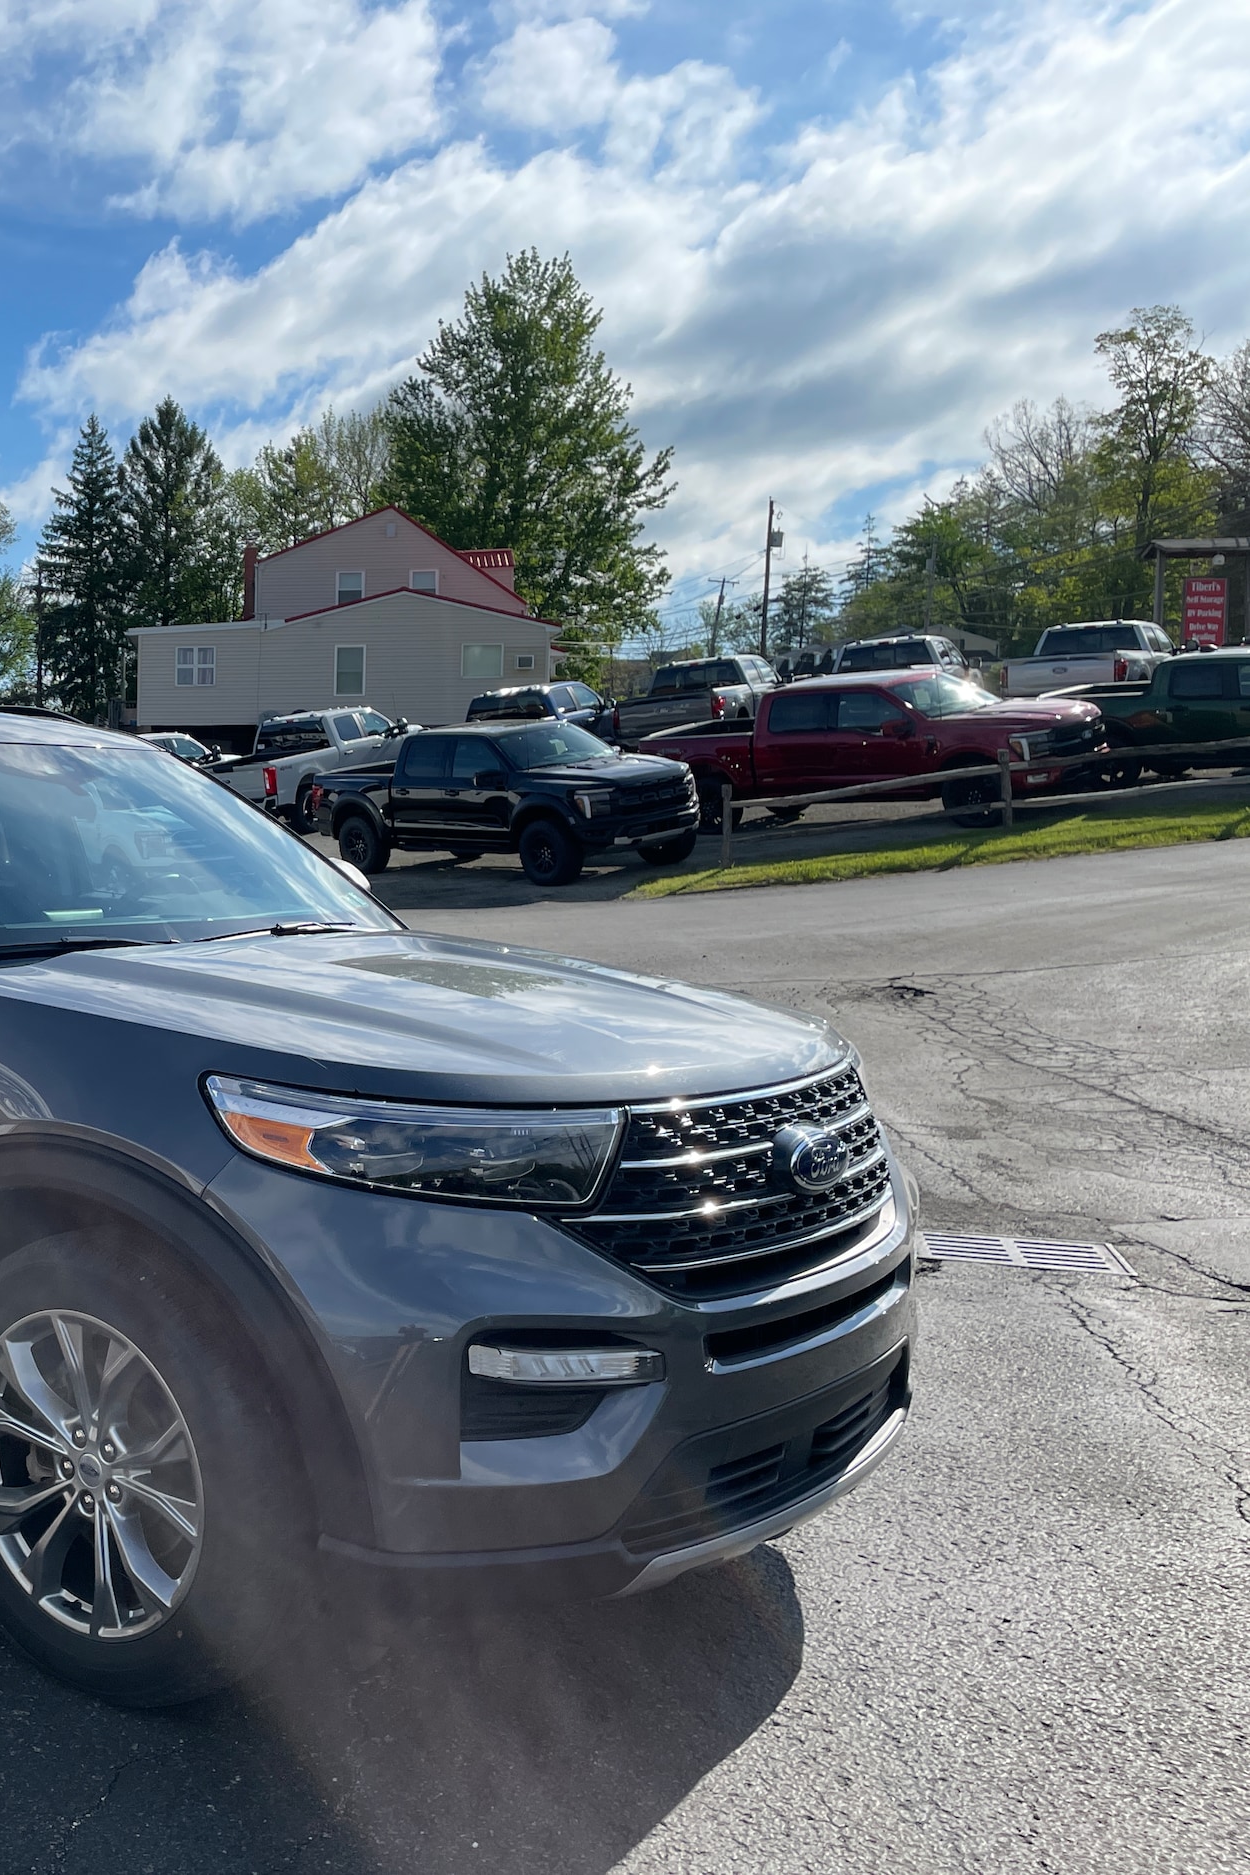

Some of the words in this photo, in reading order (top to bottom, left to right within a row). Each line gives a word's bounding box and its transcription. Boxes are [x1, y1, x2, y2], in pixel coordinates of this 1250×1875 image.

[1186, 595, 1199, 604] Self
[1200, 595, 1225, 605] Storage
[1187, 609, 1196, 617] RV
[1197, 608, 1222, 619] Parking
[1189, 622, 1206, 631] Drive
[1207, 622, 1219, 632] Way
